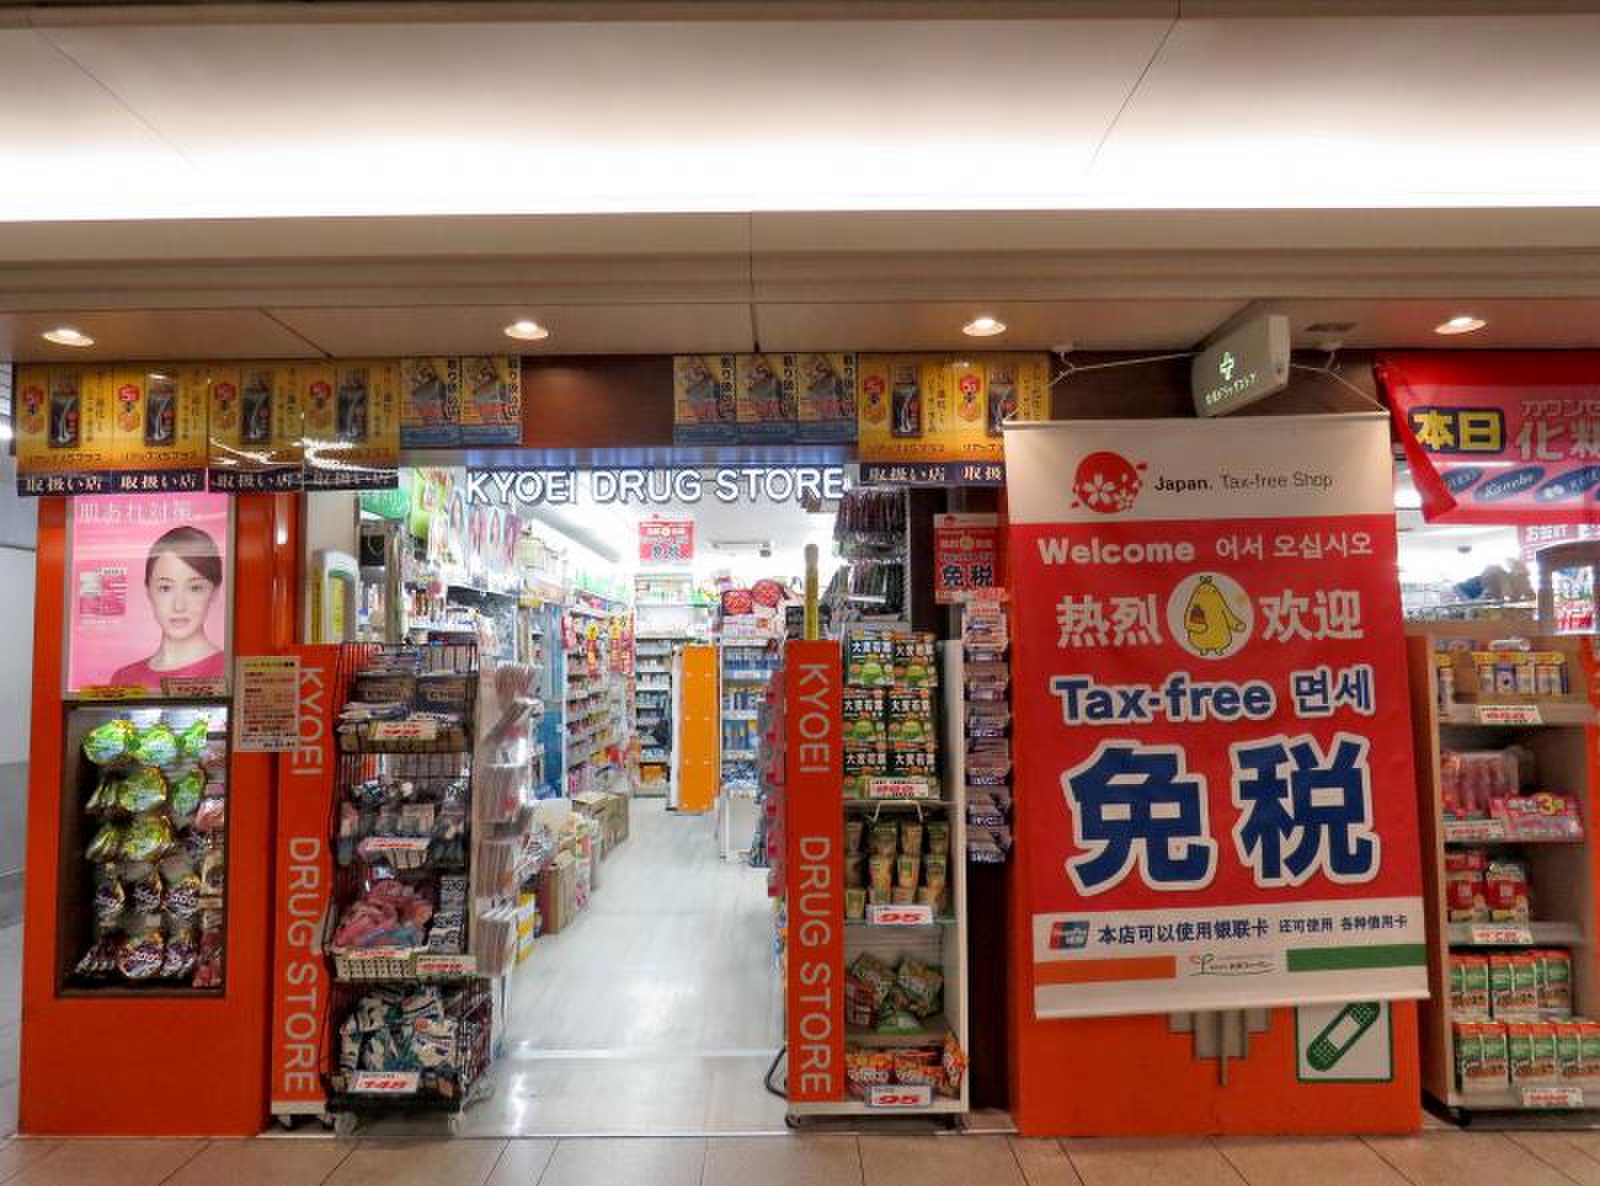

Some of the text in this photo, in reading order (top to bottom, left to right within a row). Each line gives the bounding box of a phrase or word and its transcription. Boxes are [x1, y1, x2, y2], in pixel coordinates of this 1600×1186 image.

[1412, 408, 1502, 452] 本日
[27, 473, 103, 493] 取扱い店
[120, 471, 197, 490] 取扱い店
[466, 467, 846, 503] KYOEI DRUG STORE
[1154, 471, 1334, 494] Japan. Tax-free Shop
[1038, 539, 1195, 563] Welcome
[1216, 532, 1373, 560] 어서 오십시오
[1055, 588, 1365, 649] 热烈 欢迎
[1051, 673, 1276, 724] Tax-free
[1293, 666, 1375, 717] 면세
[1065, 736, 1378, 892] 免税
[283, 665, 325, 1092] KYOEI DRUG STORE
[798, 662, 833, 1094] KYOEI DRUG STORE
[1098, 917, 1269, 945] 本店可以使用银联卡
